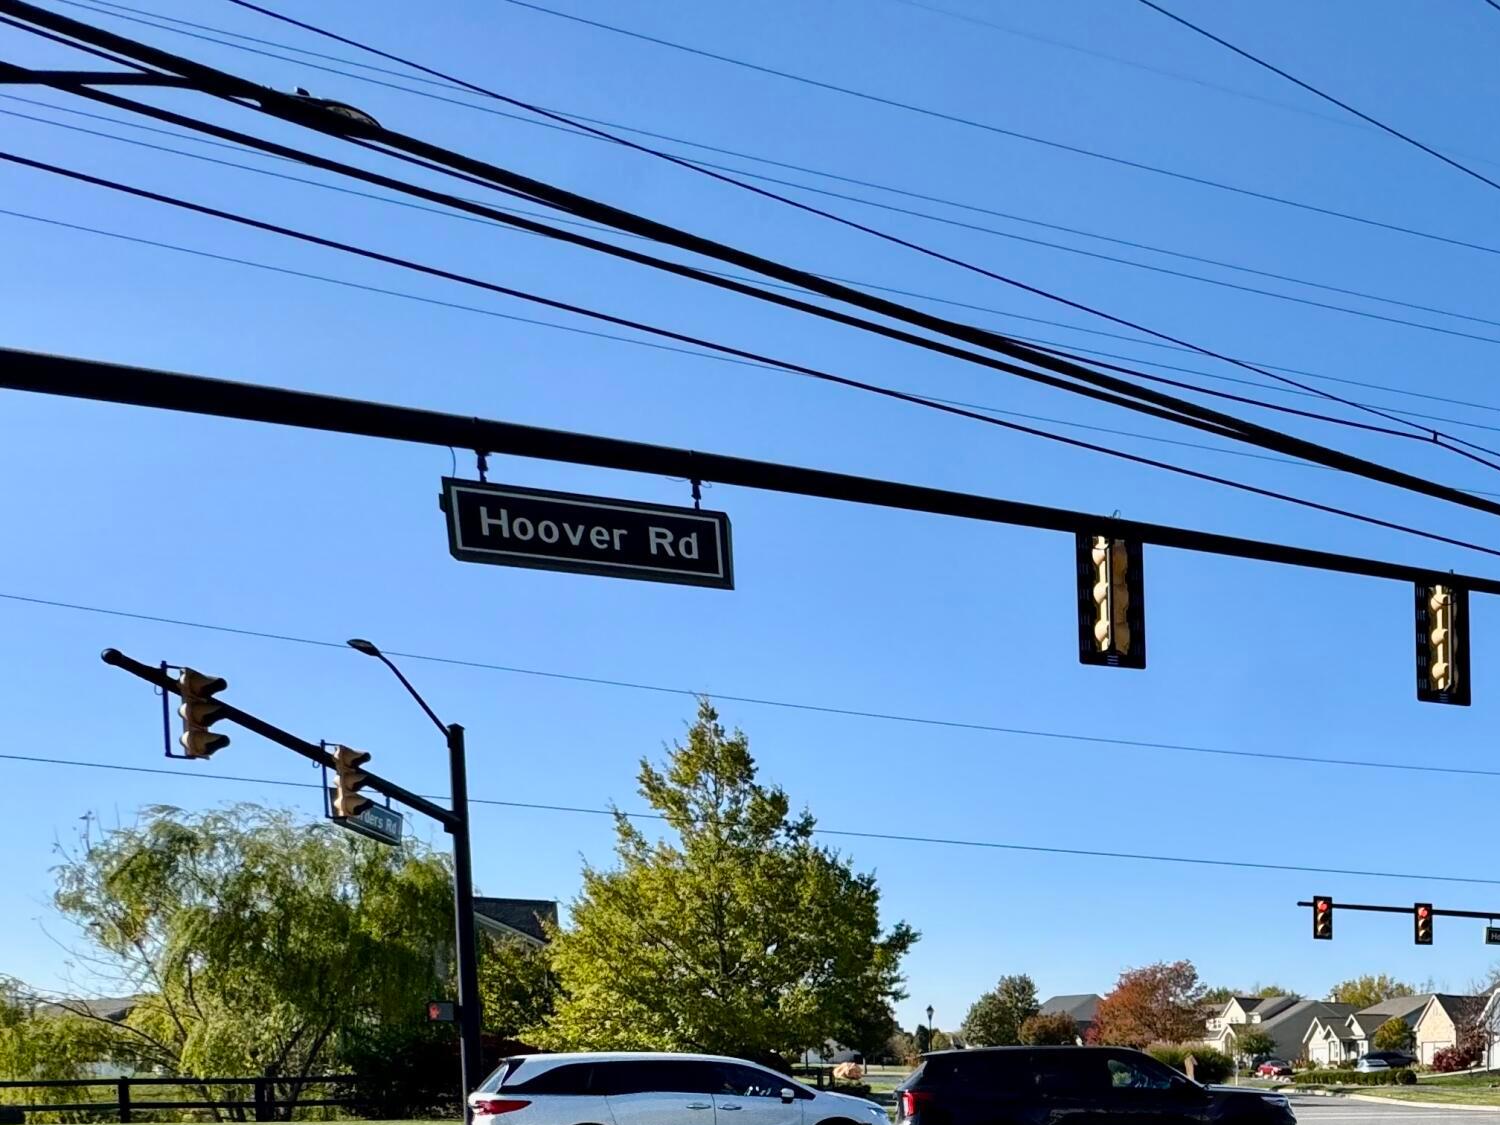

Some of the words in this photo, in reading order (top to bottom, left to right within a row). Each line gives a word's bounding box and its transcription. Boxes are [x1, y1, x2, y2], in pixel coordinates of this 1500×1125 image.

[479, 506, 628, 550] Hoover
[649, 526, 699, 559] Rd
[385, 819, 397, 834] Rd
